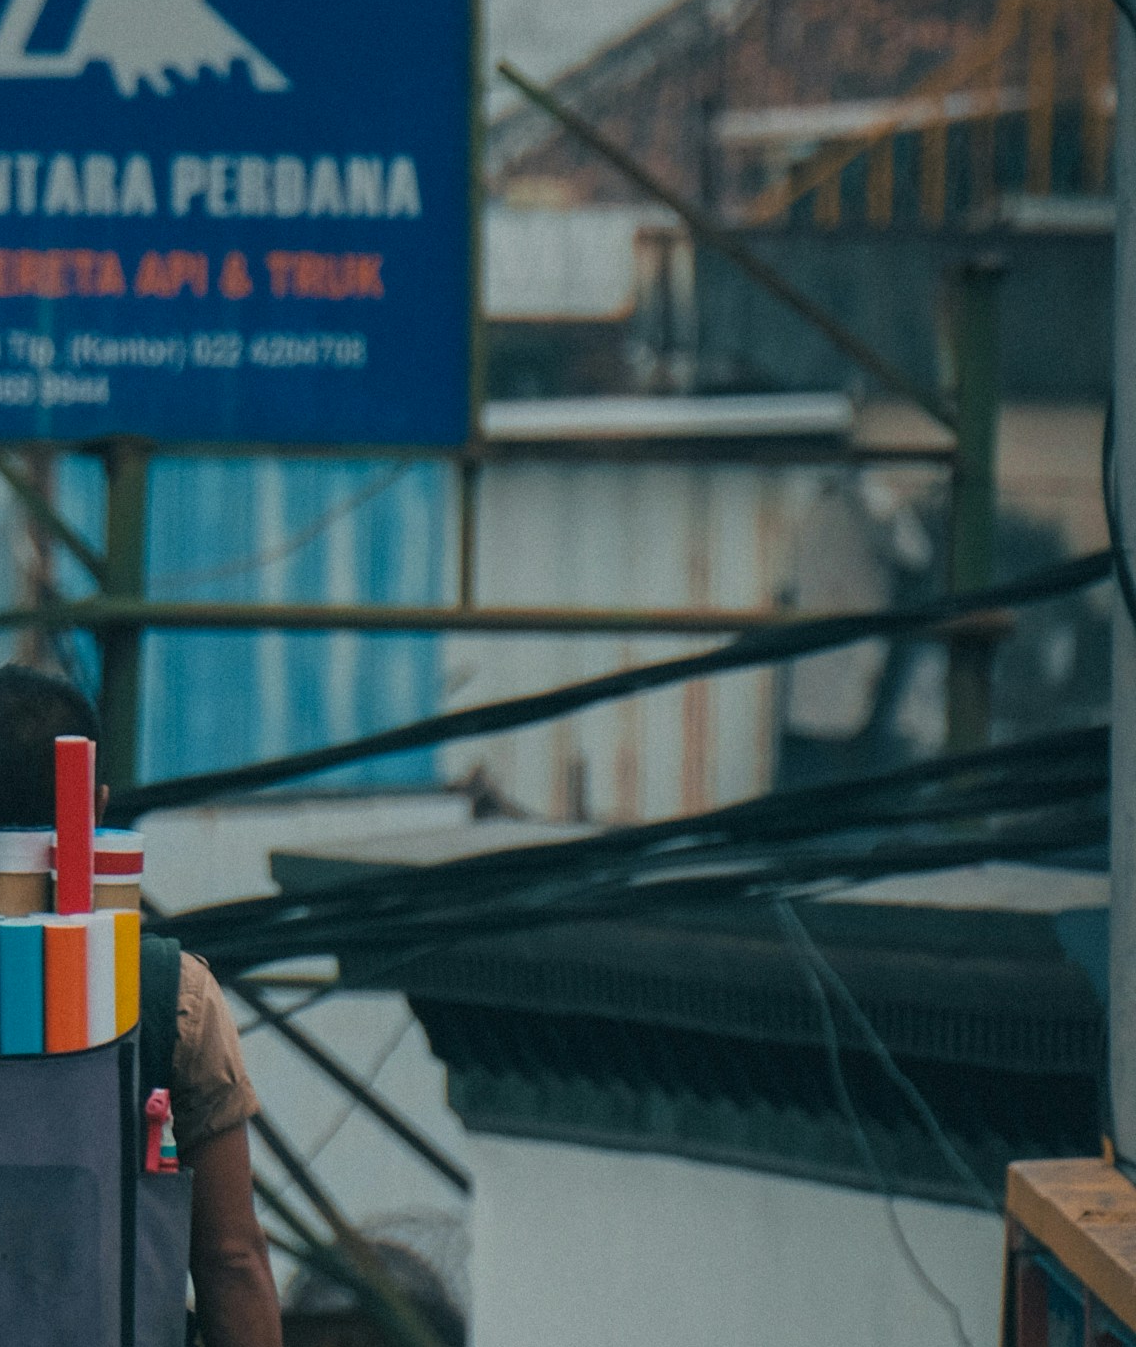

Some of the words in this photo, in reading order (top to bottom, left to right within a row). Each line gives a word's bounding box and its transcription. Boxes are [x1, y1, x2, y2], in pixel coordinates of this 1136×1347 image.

[169, 154, 422, 219] PERDANA
[134, 250, 209, 299] API
[219, 250, 254, 300] &
[265, 250, 385, 300] TRUK
